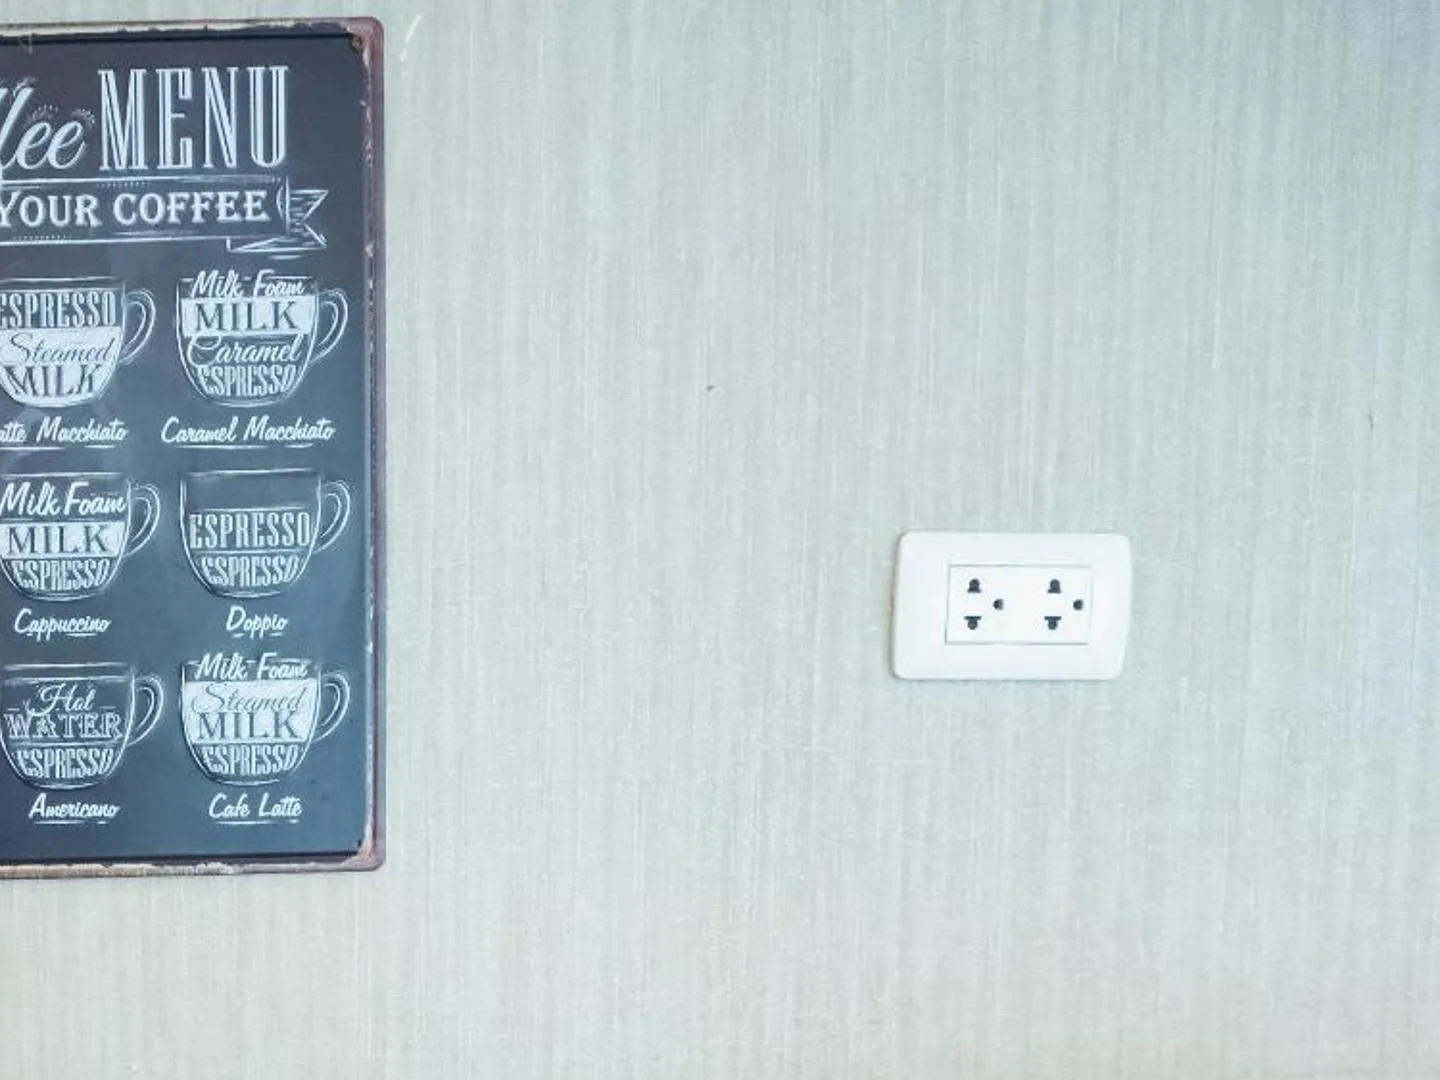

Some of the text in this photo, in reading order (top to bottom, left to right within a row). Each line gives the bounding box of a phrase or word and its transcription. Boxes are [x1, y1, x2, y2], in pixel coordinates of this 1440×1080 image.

[98, 65, 289, 171] MENU
[113, 189, 269, 226] COFFEE
[190, 269, 306, 298] Milk Foam
[195, 301, 299, 332] MILK
[187, 330, 305, 368] Caramel
[3, 364, 102, 397] MILK
[197, 364, 297, 397] ESPRESSO
[36, 416, 129, 444] Macchiato
[161, 414, 337, 443] Caramel Macchiato
[63, 482, 128, 516] Foam
[8, 524, 108, 555] MILK
[189, 511, 310, 550] ESPRESSO
[11, 558, 110, 591] ESPRESSO
[201, 554, 300, 587] ESPRESSO
[14, 607, 112, 642] Cappuccino
[226, 605, 289, 639] Doppio
[194, 652, 309, 680] Milk Foam
[26, 683, 97, 716] Hot
[191, 682, 309, 712] Steamed
[4, 711, 124, 742] WATER
[197, 711, 300, 740] MILK
[13, 747, 114, 779] ESPRESSO
[200, 743, 300, 776] ESPRESSO
[28, 792, 121, 819] Americano
[209, 791, 303, 819] Cafe Latte
